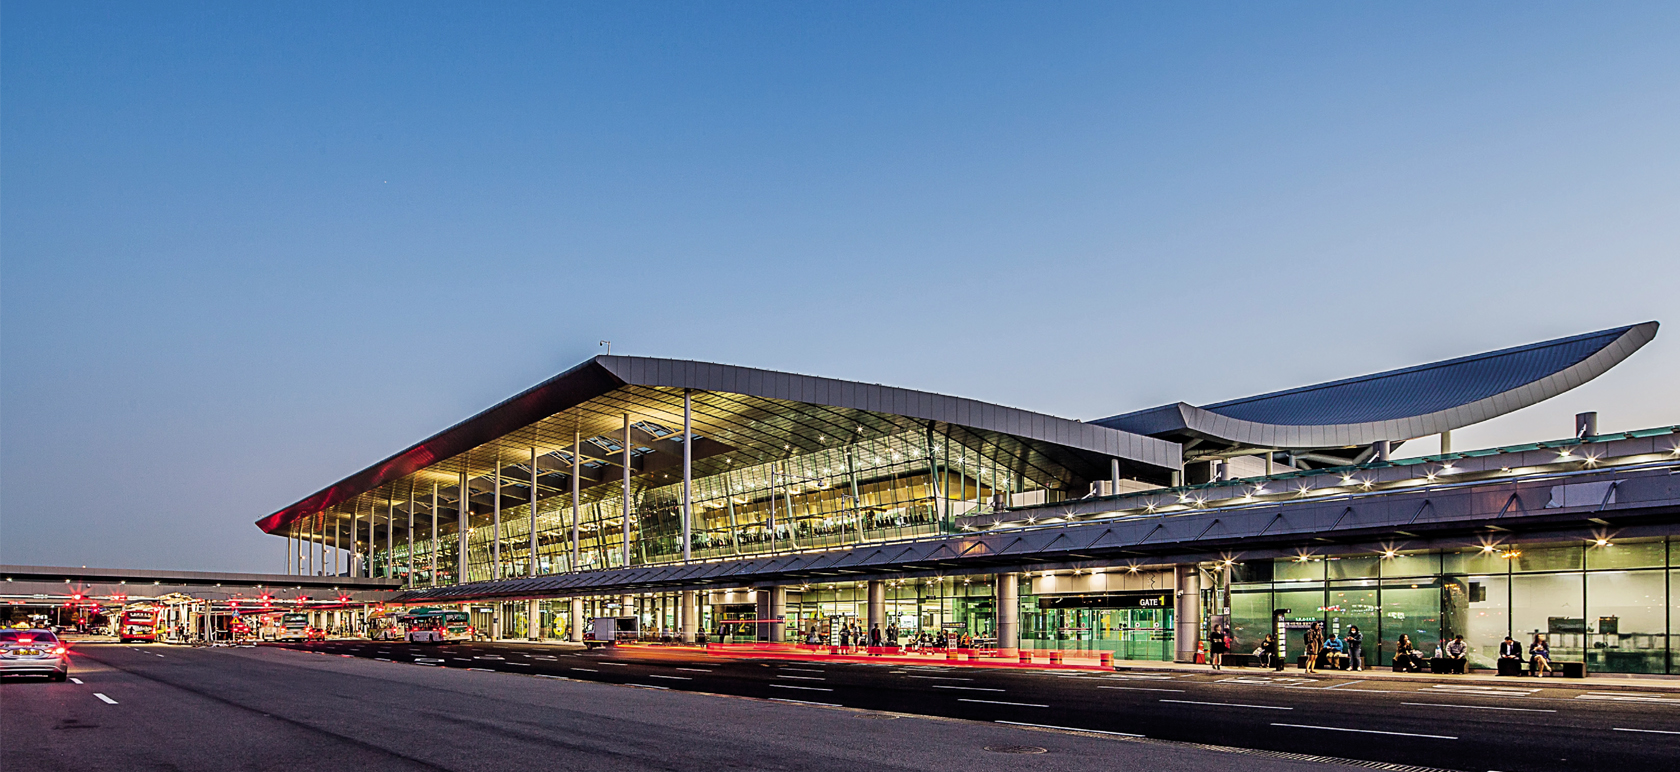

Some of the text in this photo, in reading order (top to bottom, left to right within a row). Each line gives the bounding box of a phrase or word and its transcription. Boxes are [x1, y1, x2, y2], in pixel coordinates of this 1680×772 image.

[1139, 595, 1165, 606] GATE 1
[553, 617, 566, 635] 3
[738, 617, 745, 633] 2
[1101, 615, 1111, 638] 1
